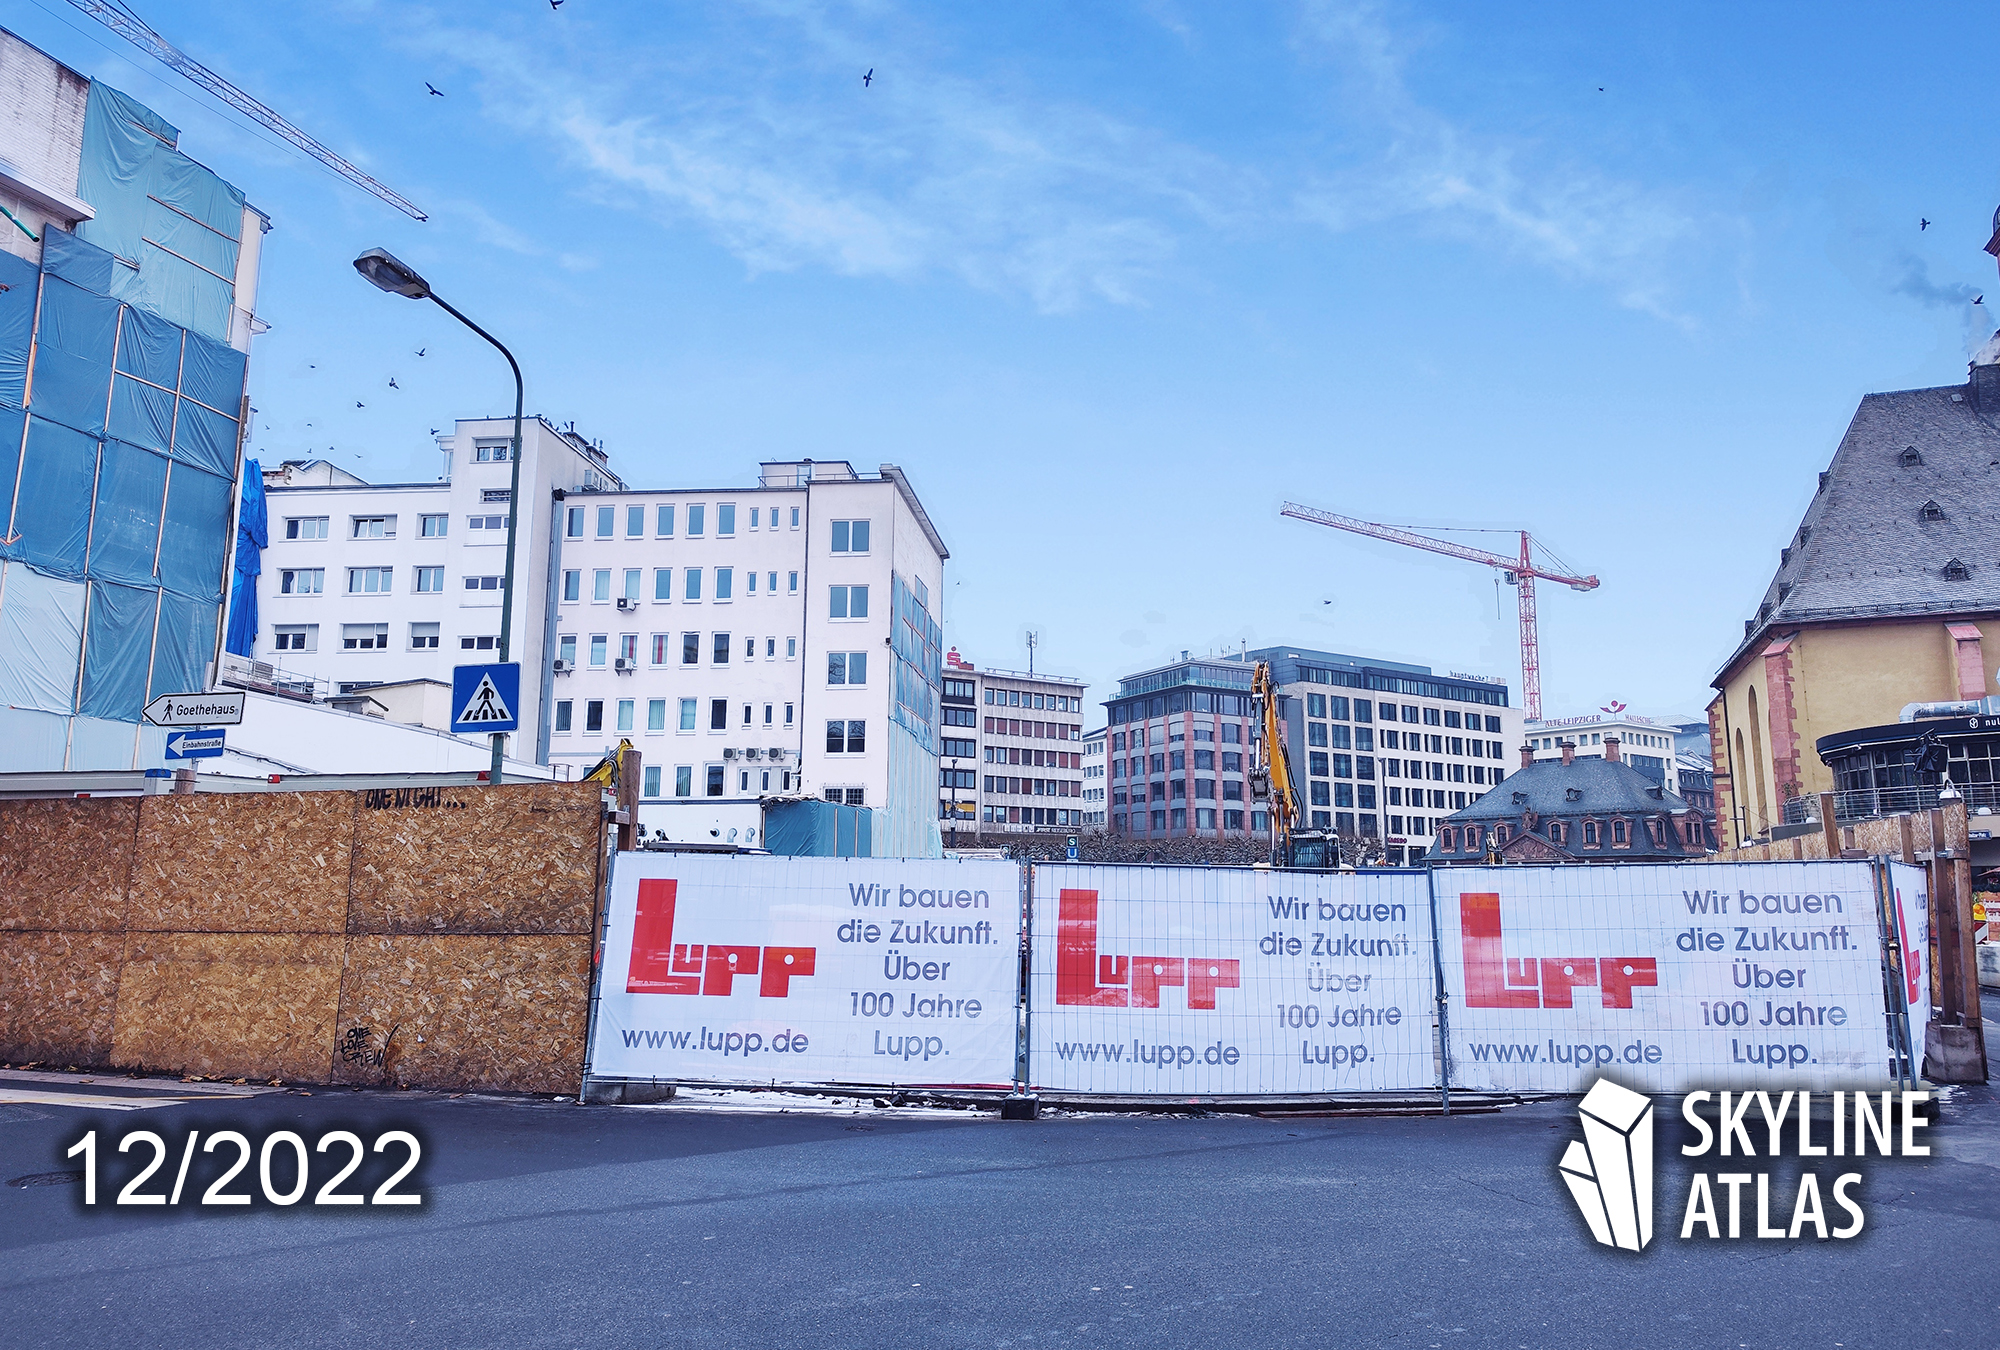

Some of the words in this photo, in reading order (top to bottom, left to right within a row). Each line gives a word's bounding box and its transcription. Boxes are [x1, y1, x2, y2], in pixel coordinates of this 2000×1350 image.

[176, 703, 235, 716] Goethehaus
[1563, 714, 1601, 726] LEIPZIGER
[182, 739, 221, 749] Einbahnstraße
[1067, 848, 1077, 858] U
[1068, 837, 1076, 846] S
[848, 883, 891, 908] Wir
[900, 883, 990, 909] bauen
[1267, 896, 1310, 921] Wir
[1318, 897, 1406, 922] bauen
[1683, 890, 1729, 914] Wir
[1740, 889, 1843, 914] bauen
[837, 919, 881, 944] die
[890, 920, 998, 945] Zukunft.
[1260, 932, 1302, 956] die
[1311, 932, 1417, 957] Zukunft.
[1676, 927, 1725, 952] die
[1735, 926, 1858, 952] Zukunft.
[884, 950, 950, 981] Über
[1308, 962, 1372, 993] Über
[1732, 958, 1806, 989] Über
[851, 992, 894, 1017] 100
[902, 993, 982, 1019] Jahre
[1277, 1004, 1319, 1029] 100
[1327, 1004, 1402, 1029] Jahre
[1700, 1001, 1749, 1026] 100
[1759, 1000, 1847, 1027] Jahre
[347, 1026, 372, 1039] ONE
[622, 1026, 809, 1057] www.lupp.de
[874, 1030, 950, 1061] Lupp.
[340, 1040, 368, 1054] LOVE
[1055, 1039, 1240, 1069] www.lupp.de
[1303, 1040, 1375, 1069] Lupp.
[1469, 1039, 1663, 1068] www.lupp.de
[1732, 1038, 1817, 1069] Lupp.
